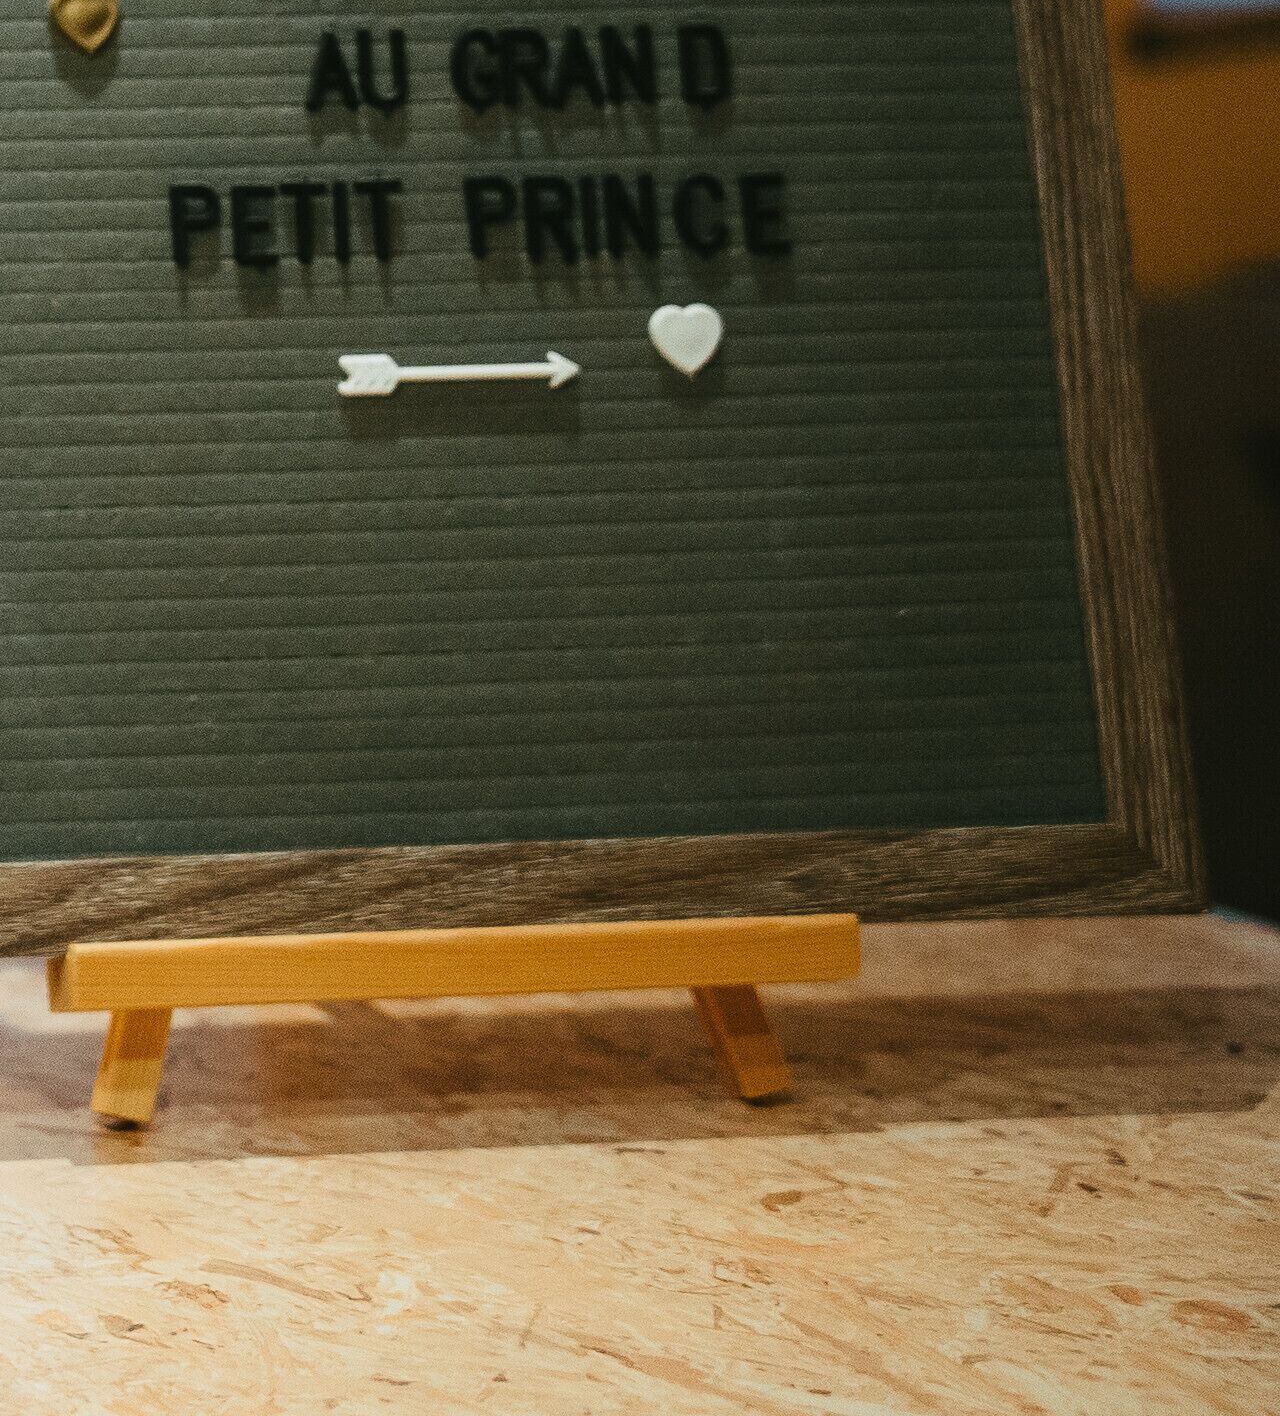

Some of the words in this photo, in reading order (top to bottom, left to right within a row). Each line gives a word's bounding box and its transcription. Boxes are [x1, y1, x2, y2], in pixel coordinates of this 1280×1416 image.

[304, 28, 410, 113] AU
[168, 180, 402, 268] PETIT
[462, 173, 792, 265] PRINCE
